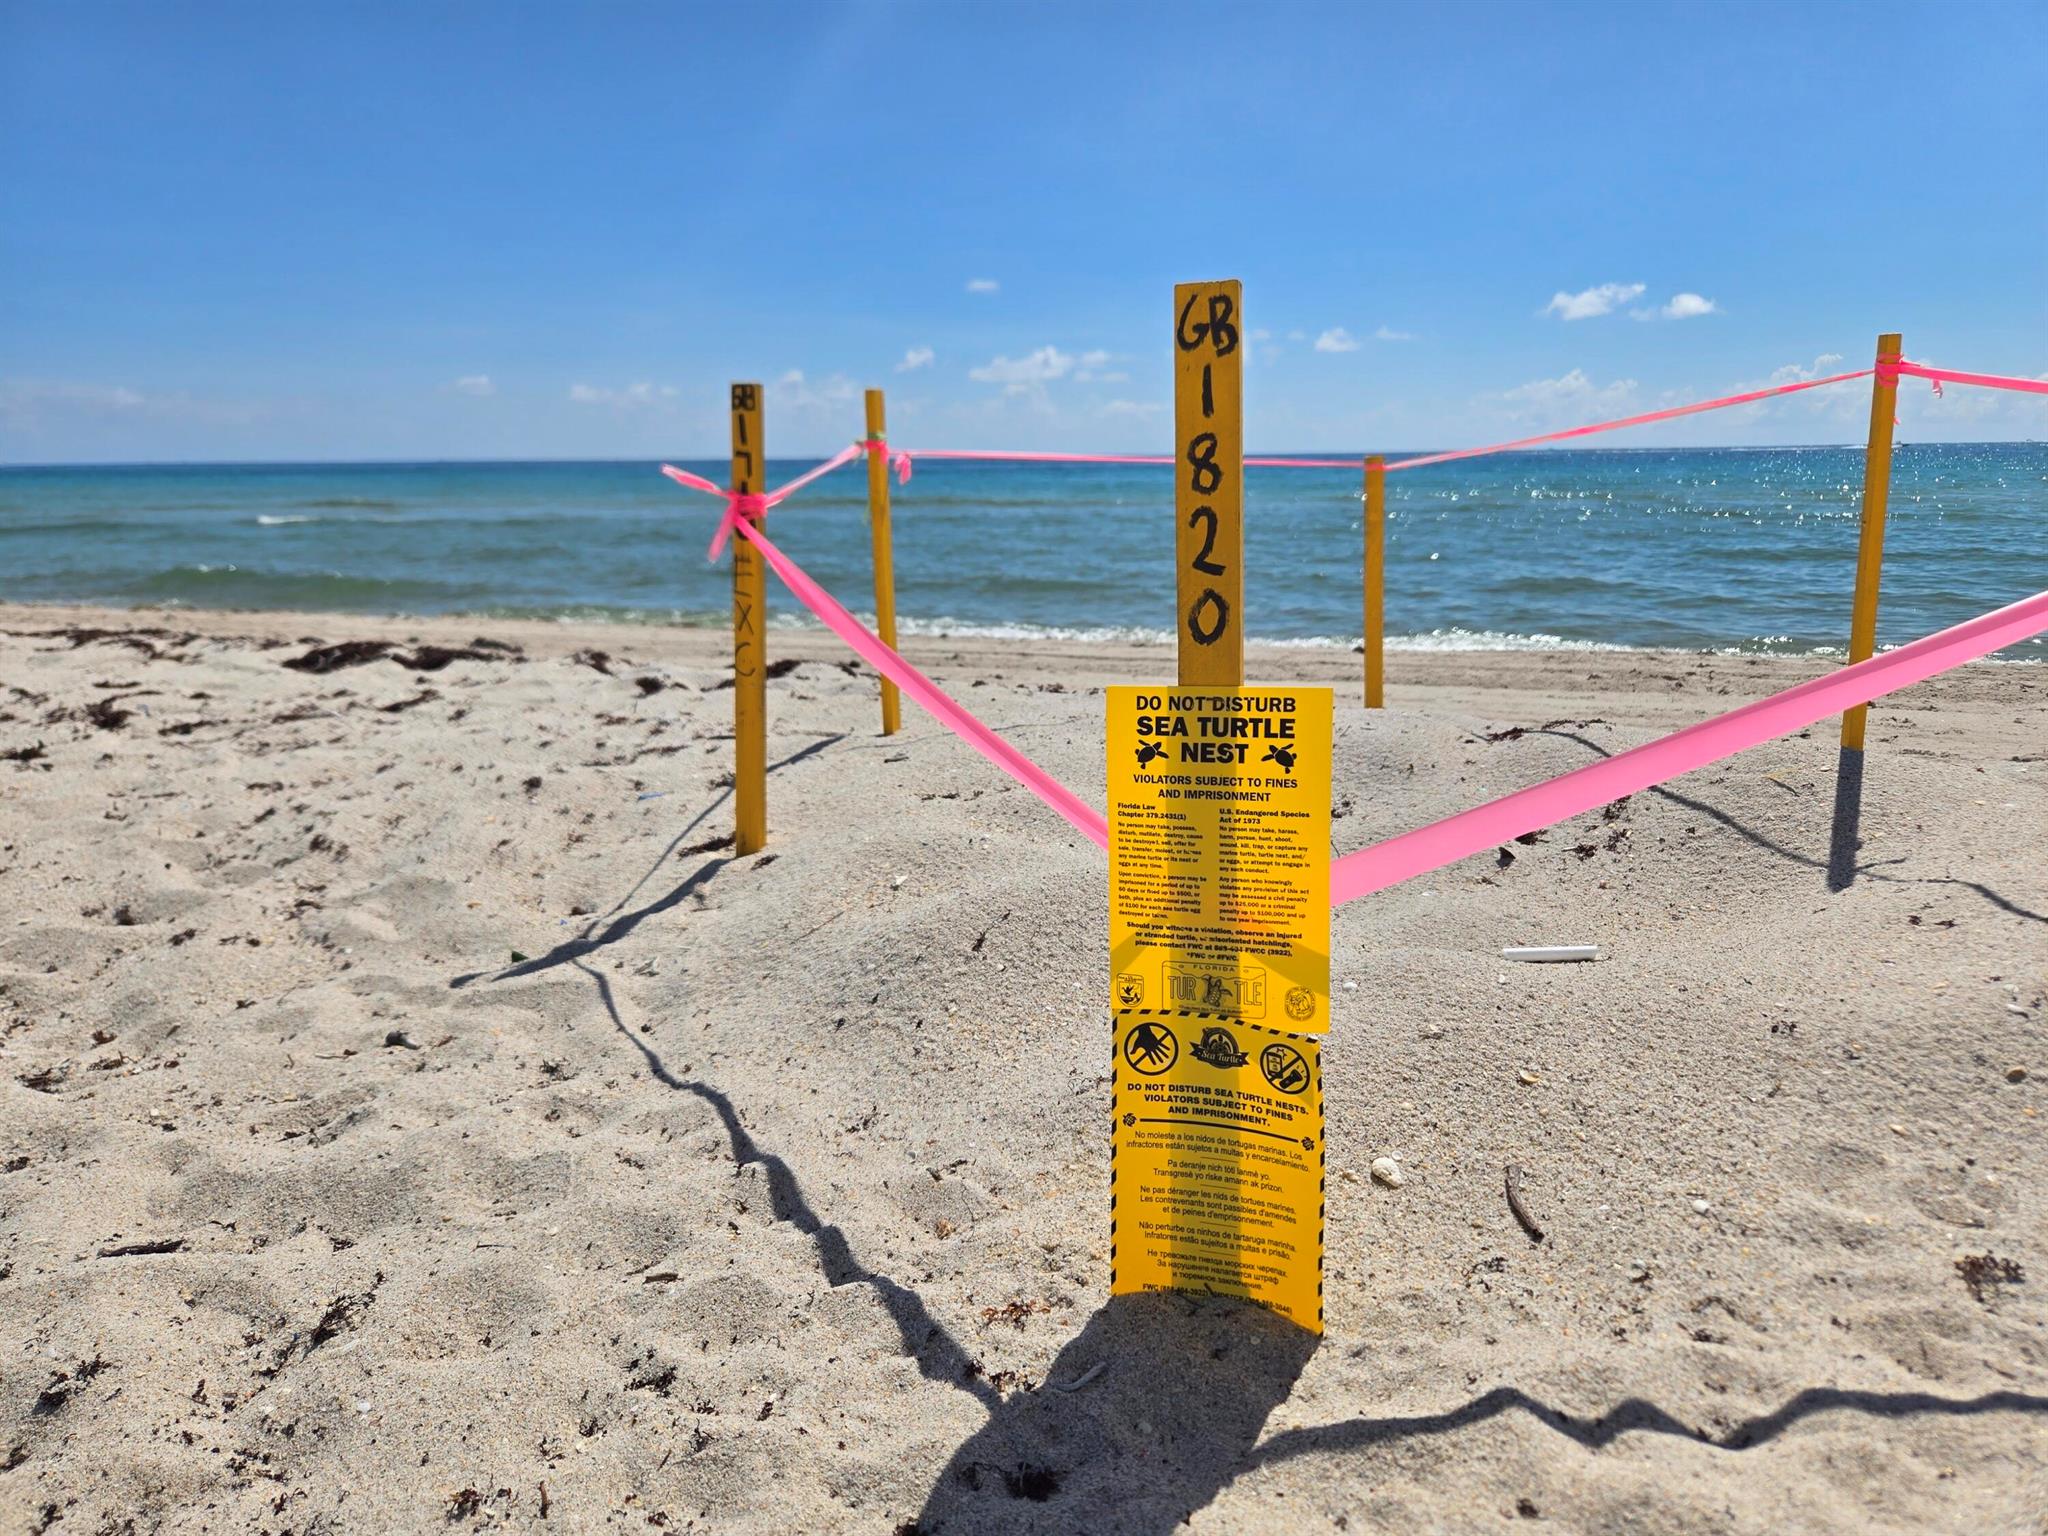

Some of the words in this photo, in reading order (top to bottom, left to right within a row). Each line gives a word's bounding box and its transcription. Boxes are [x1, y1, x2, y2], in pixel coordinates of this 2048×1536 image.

[1176, 294, 1239, 358] GB
[1136, 695, 1162, 711] DO
[1168, 695, 1206, 711] NOT
[1211, 696, 1296, 713] DISTURB
[1136, 715, 1189, 737] SEA
[1197, 716, 1296, 739] TURTLE
[1181, 742, 1249, 764] NEST
[1133, 774, 1192, 785] VIOLATORS
[1195, 776, 1244, 787] SUBJECT
[1247, 777, 1262, 787] TO
[1265, 778, 1298, 789] FINES
[1158, 788, 1181, 799] AND
[1184, 789, 1272, 802] IMPRISONMENT
[1118, 810, 1144, 818] Chapter
[1146, 812, 1187, 821] 379.2431(1)
[1235, 809, 1279, 817] Endangered
[1253, 939, 1293, 948] hatchlings,
[1193, 964, 1235, 973] FLORIDA
[1167, 975, 1197, 1001] TUR
[1234, 980, 1263, 1006] TLE
[1202, 1050, 1216, 1060] Sea
[1217, 1053, 1239, 1064] Turtle
[1127, 1083, 1142, 1091] DO
[1145, 1083, 1166, 1091] NOT
[1168, 1084, 1211, 1094] DISTURB
[1214, 1088, 1234, 1098] SEA
[1236, 1091, 1272, 1106] TURTLE
[1275, 1100, 1309, 1115] NESTS.
[1144, 1094, 1200, 1104] VIOLATORS
[1202, 1098, 1247, 1111] SUBJECT
[1250, 1104, 1263, 1114] TO
[1265, 1108, 1293, 1121] FINES
[1168, 1106, 1189, 1114] AND
[1191, 1107, 1271, 1127] IMPRISONMENT.
[1126, 1141, 1163, 1149] infractores
[1165, 1141, 1185, 1150] están
[1187, 1143, 1212, 1153] sujetos
[1220, 1146, 1244, 1157] multas
[1245, 1152, 1251, 1160] y
[1135, 1130, 1145, 1139] No
[1147, 1131, 1175, 1140] moleste
[1183, 1133, 1194, 1141] los
[1195, 1134, 1215, 1143] nidos
[1216, 1136, 1227, 1144] de
[1227, 1138, 1257, 1150] tortugas
[1257, 1143, 1289, 1157] marinas.
[1289, 1151, 1303, 1161] Los
[1167, 1159, 1178, 1168] Pa
[1179, 1160, 1206, 1172] deranje
[1207, 1163, 1223, 1172] nich
[1195, 1171, 1204, 1180] yo
[1205, 1172, 1223, 1182] riske
[1250, 1180, 1259, 1188] ak
[1140, 1185, 1150, 1193] Ne
[1152, 1187, 1166, 1195] pas
[1167, 1186, 1199, 1198] déranger
[1200, 1189, 1211, 1198] les
[1213, 1192, 1228, 1201] nids
[1229, 1194, 1239, 1203] de
[1240, 1196, 1265, 1208] tortues
[1140, 1195, 1153, 1203] Les
[1154, 1196, 1205, 1207] contrevenants
[1206, 1200, 1222, 1209] sont
[1223, 1203, 1257, 1215] passibles
[1258, 1209, 1297, 1224] d'amendes
[1171, 1206, 1181, 1214] de
[1181, 1208, 1206, 1217] peines
[1138, 1221, 1153, 1230] Não
[1155, 1223, 1185, 1233] perturbe
[1196, 1228, 1220, 1238] ninhos
[1222, 1231, 1232, 1239] de
[1233, 1233, 1265, 1246] tartaruga
[1144, 1231, 1178, 1241] Infratores
[1179, 1235, 1199, 1244] estão
[1200, 1237, 1228, 1249] sujeitos
[1229, 1242, 1235, 1250] a
[1235, 1243, 1260, 1254] multas
[1147, 1248, 1158, 1257] Не
[1156, 1259, 1167, 1268] За
[1142, 1283, 1159, 1291] FWC
